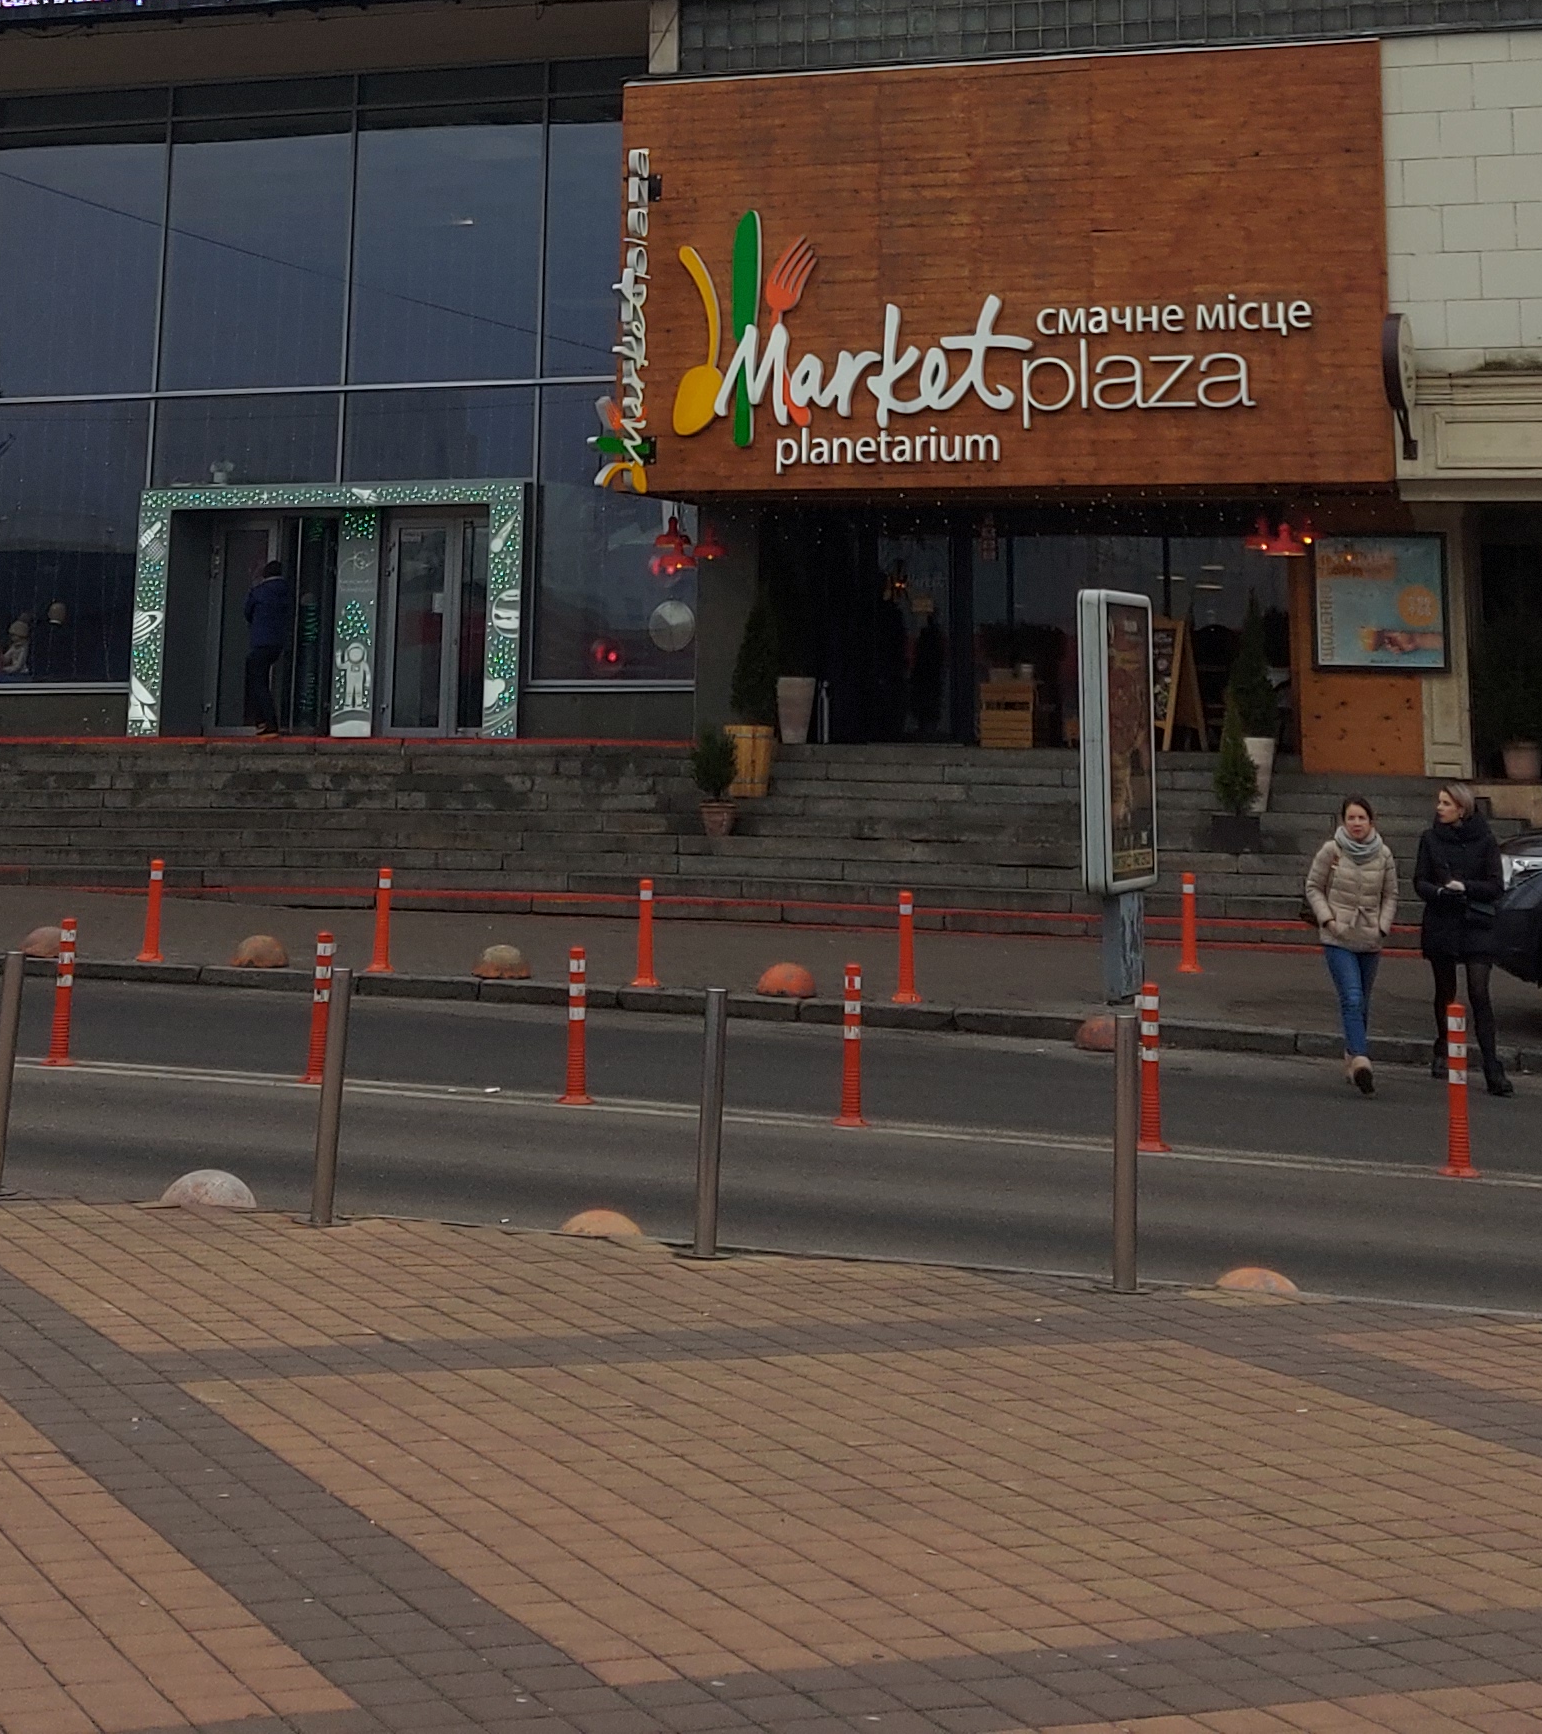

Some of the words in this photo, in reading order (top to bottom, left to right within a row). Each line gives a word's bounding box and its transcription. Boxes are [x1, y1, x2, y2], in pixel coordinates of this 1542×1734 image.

[1036, 304, 1185, 336] смачне
[1196, 293, 1313, 337] місце
[714, 294, 1034, 429] Market
[1022, 338, 1258, 430] plaza
[775, 426, 1001, 475] planetarium
